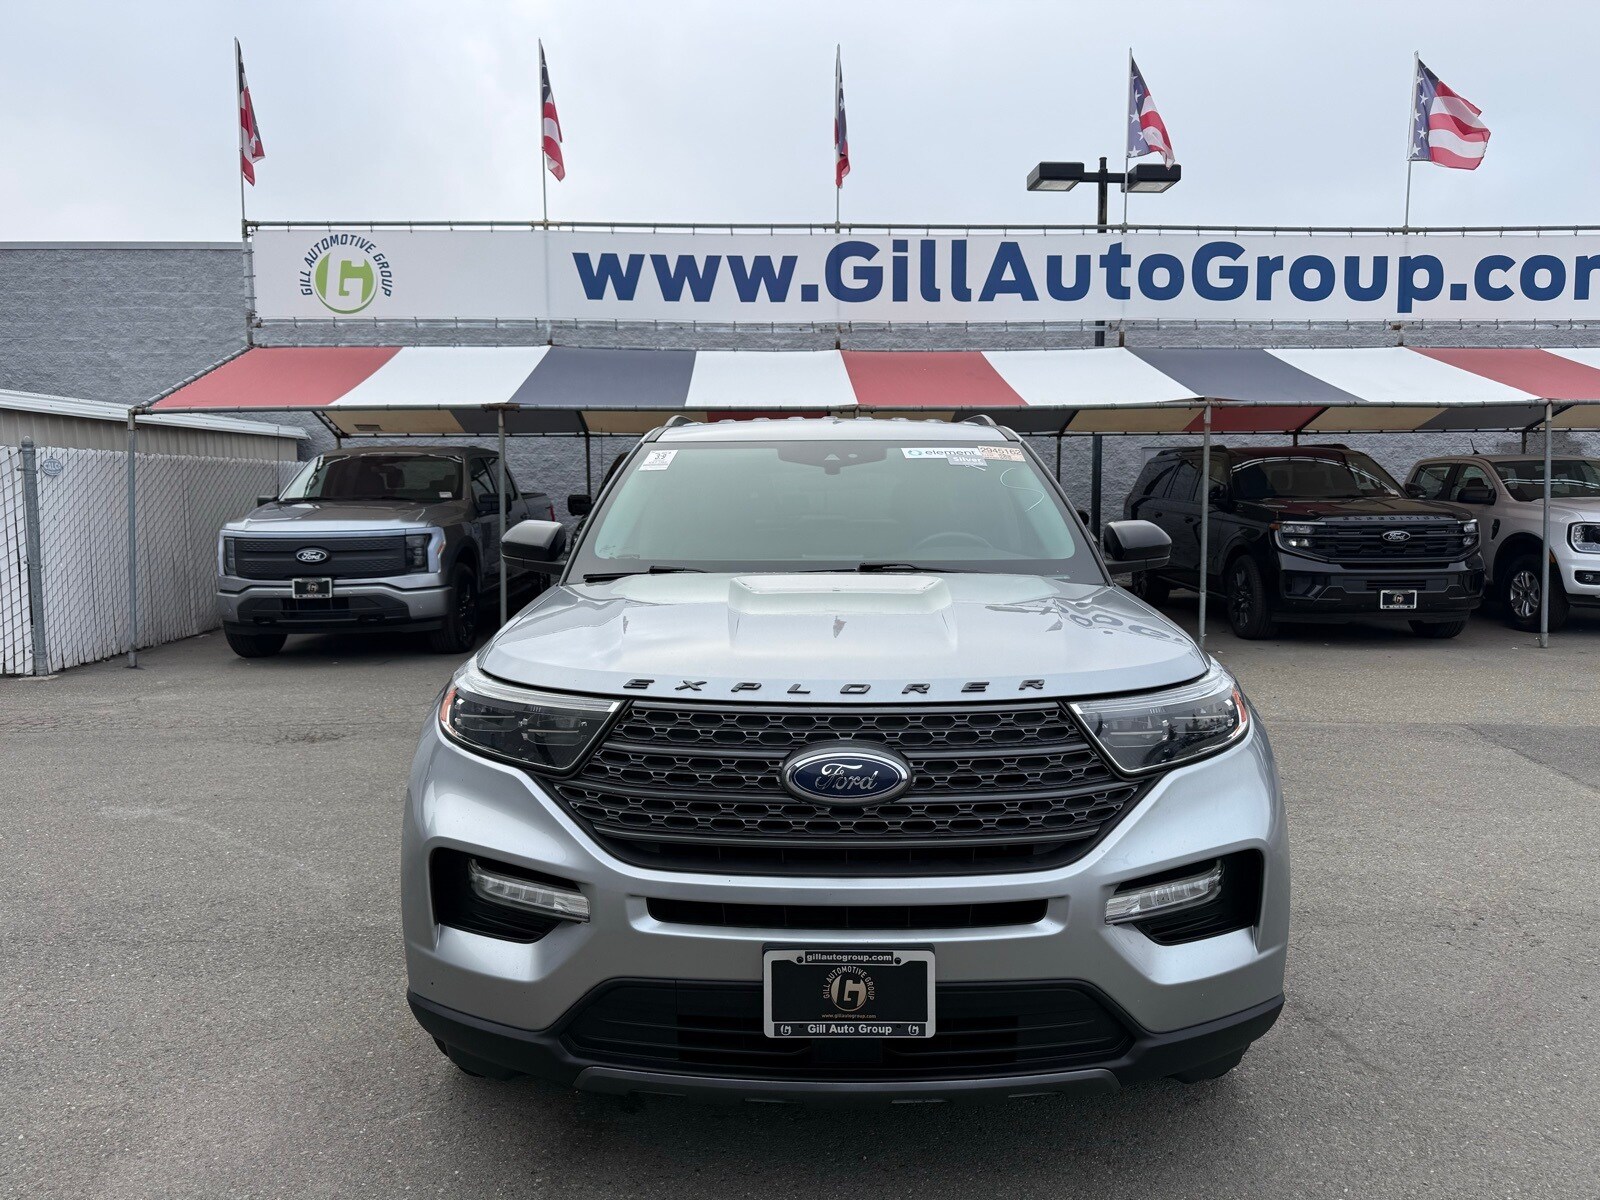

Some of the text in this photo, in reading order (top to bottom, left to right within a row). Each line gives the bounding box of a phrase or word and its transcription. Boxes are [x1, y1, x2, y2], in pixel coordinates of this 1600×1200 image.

[299, 233, 393, 297] GILL AUTOMOTIVE GROUP
[925, 449, 976, 457] element
[1387, 532, 1406, 540] Ford
[301, 551, 322, 560] Ford
[622, 677, 1045, 695] EXPLORER
[814, 763, 879, 792] Ford
[806, 952, 892, 963] gillautogroup.com
[823, 966, 875, 1001] GILL AUTOMOTIVE GROUP
[807, 1024, 893, 1036] Gill Auto Group
